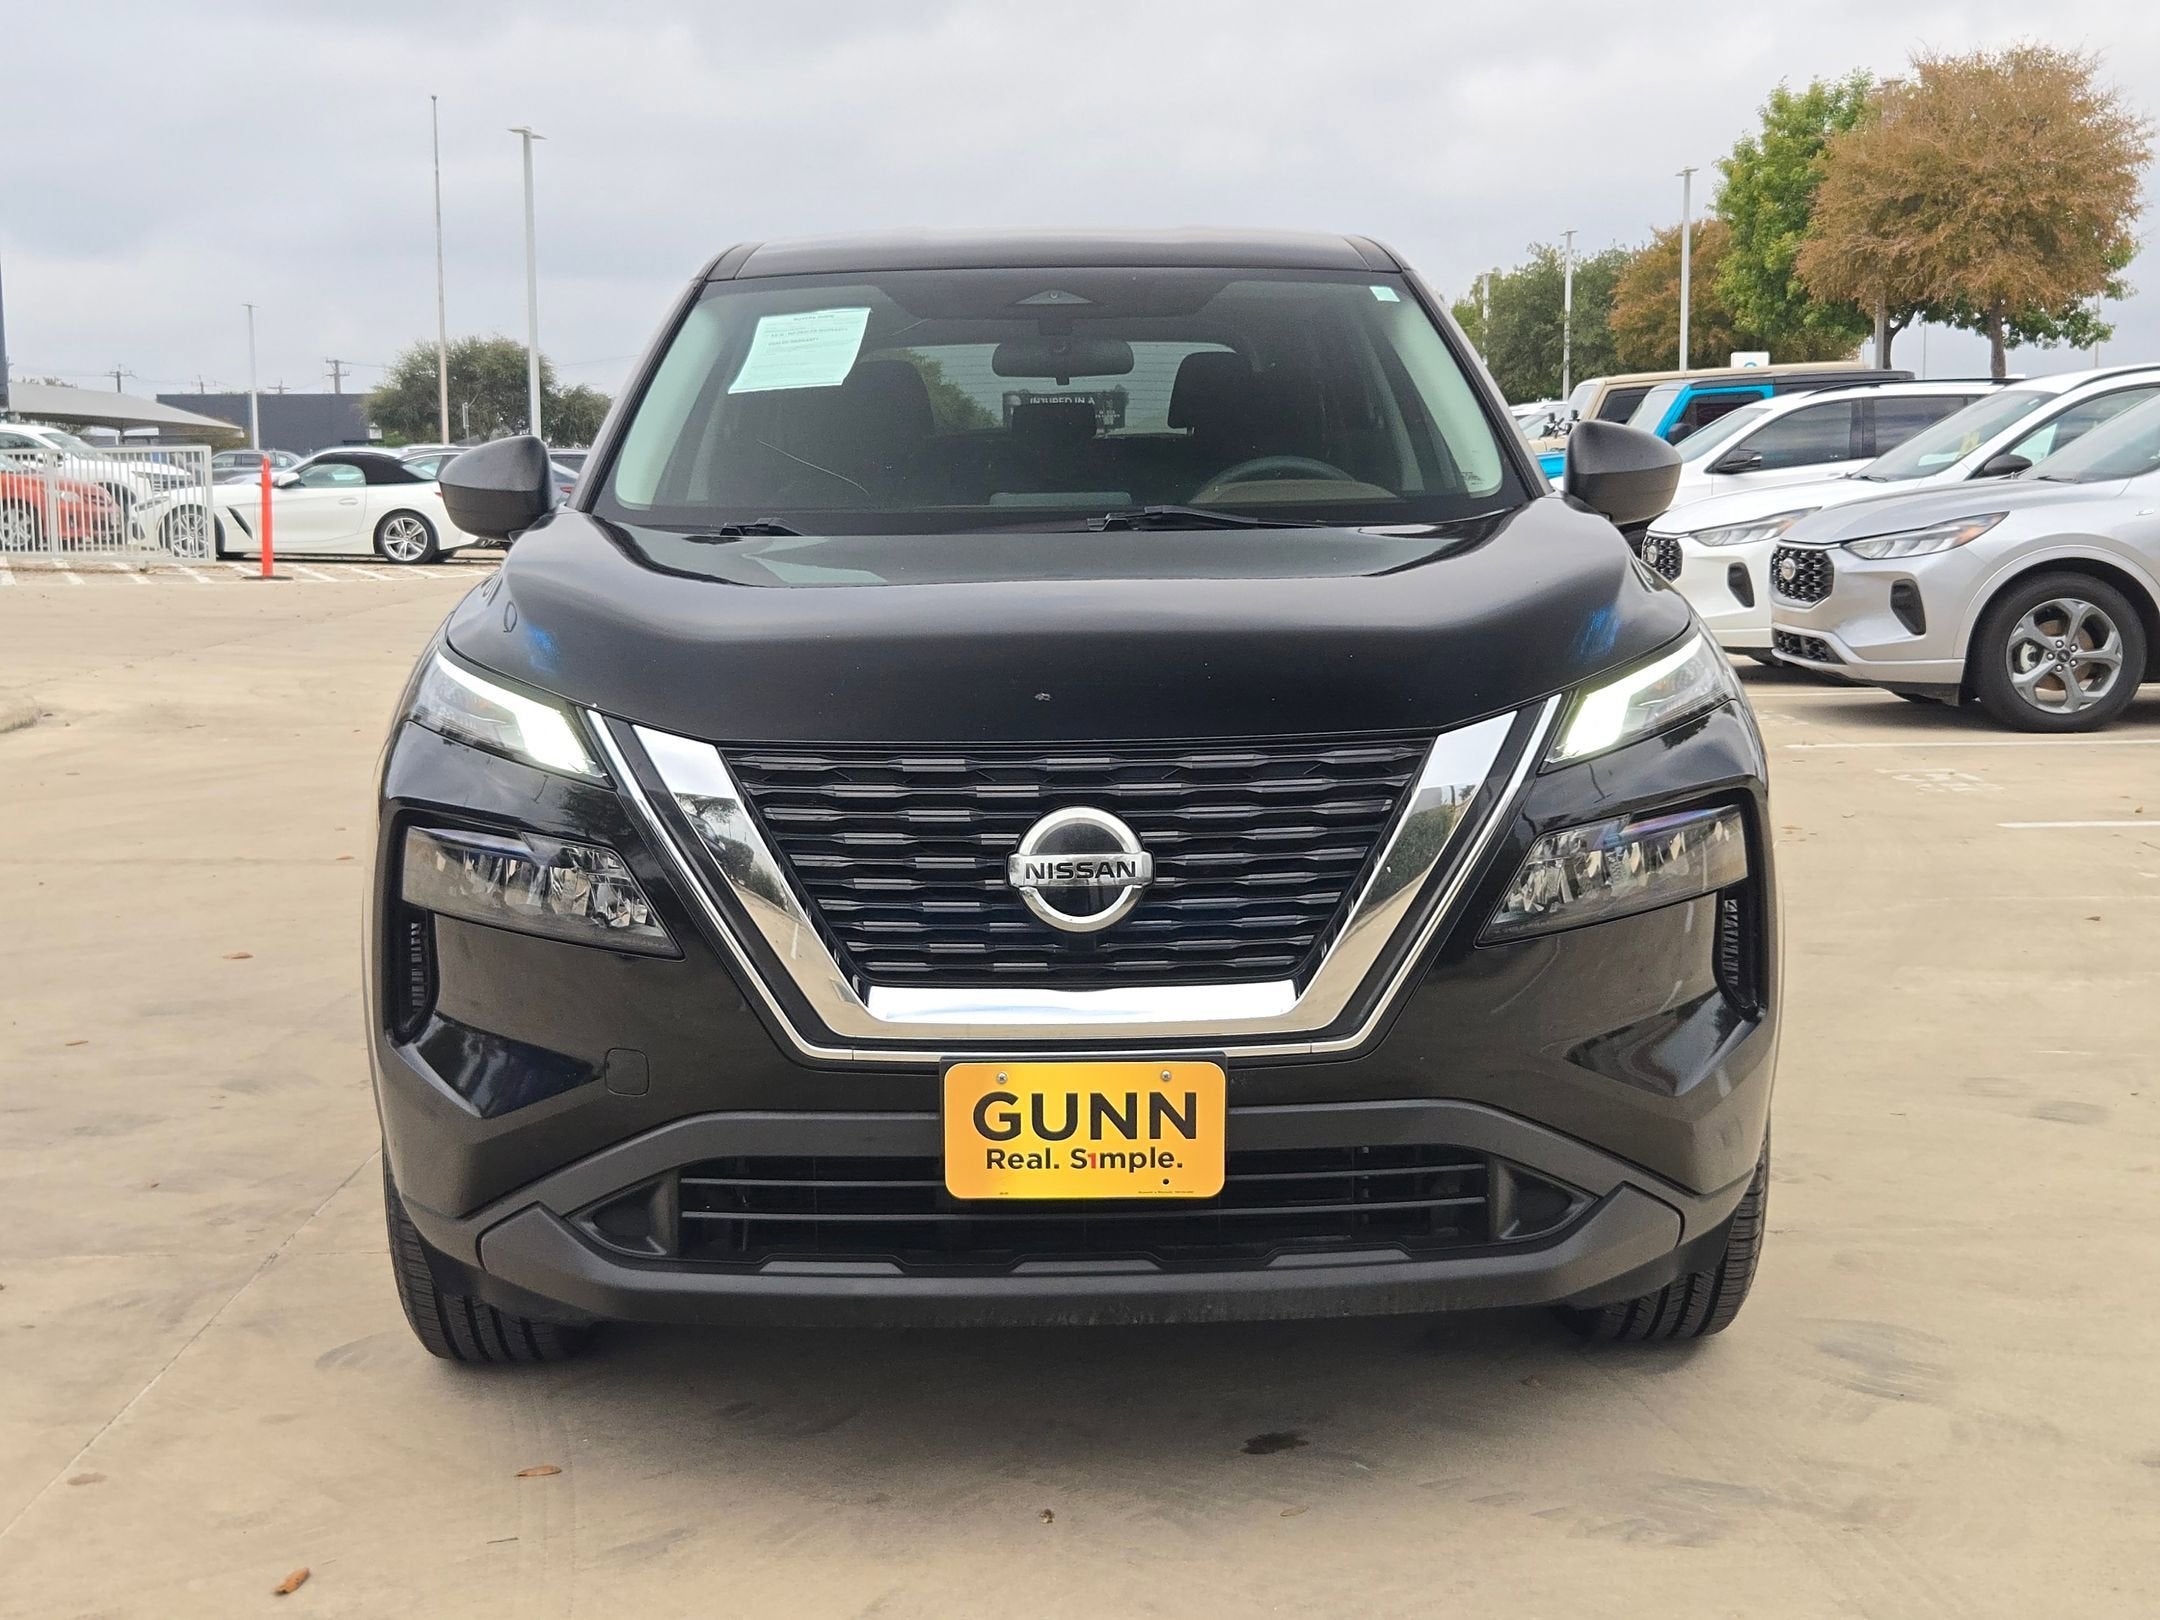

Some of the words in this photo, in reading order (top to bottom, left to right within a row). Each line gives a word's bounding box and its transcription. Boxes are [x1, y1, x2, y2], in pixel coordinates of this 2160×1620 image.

[1025, 861, 1136, 880] NISSAN
[972, 1091, 1197, 1141] GUNN
[986, 1147, 1060, 1169] Real.
